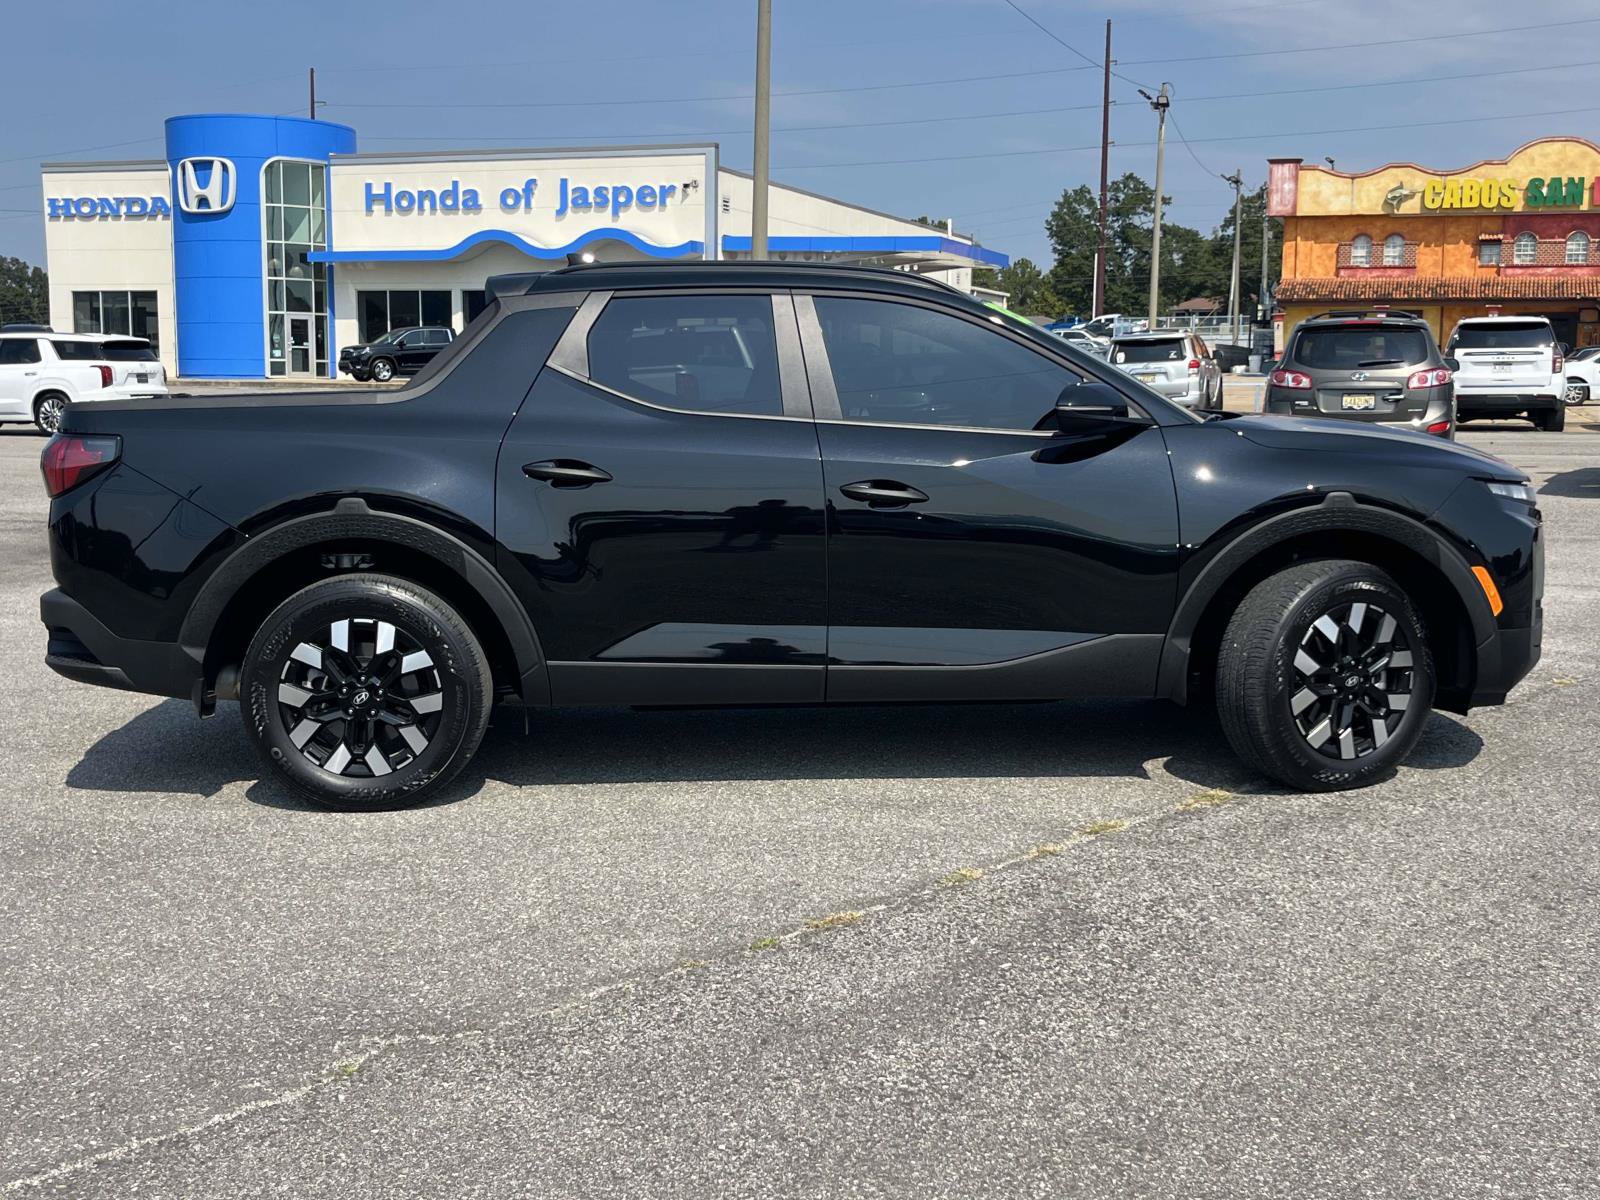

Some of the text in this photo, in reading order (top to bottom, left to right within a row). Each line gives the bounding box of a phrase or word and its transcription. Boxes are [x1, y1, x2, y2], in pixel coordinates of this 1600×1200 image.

[47, 196, 170, 217] HONDA
[364, 177, 677, 218] Honda of Jasper
[1424, 177, 1519, 209] CABOS
[1527, 176, 1585, 207] SAN
